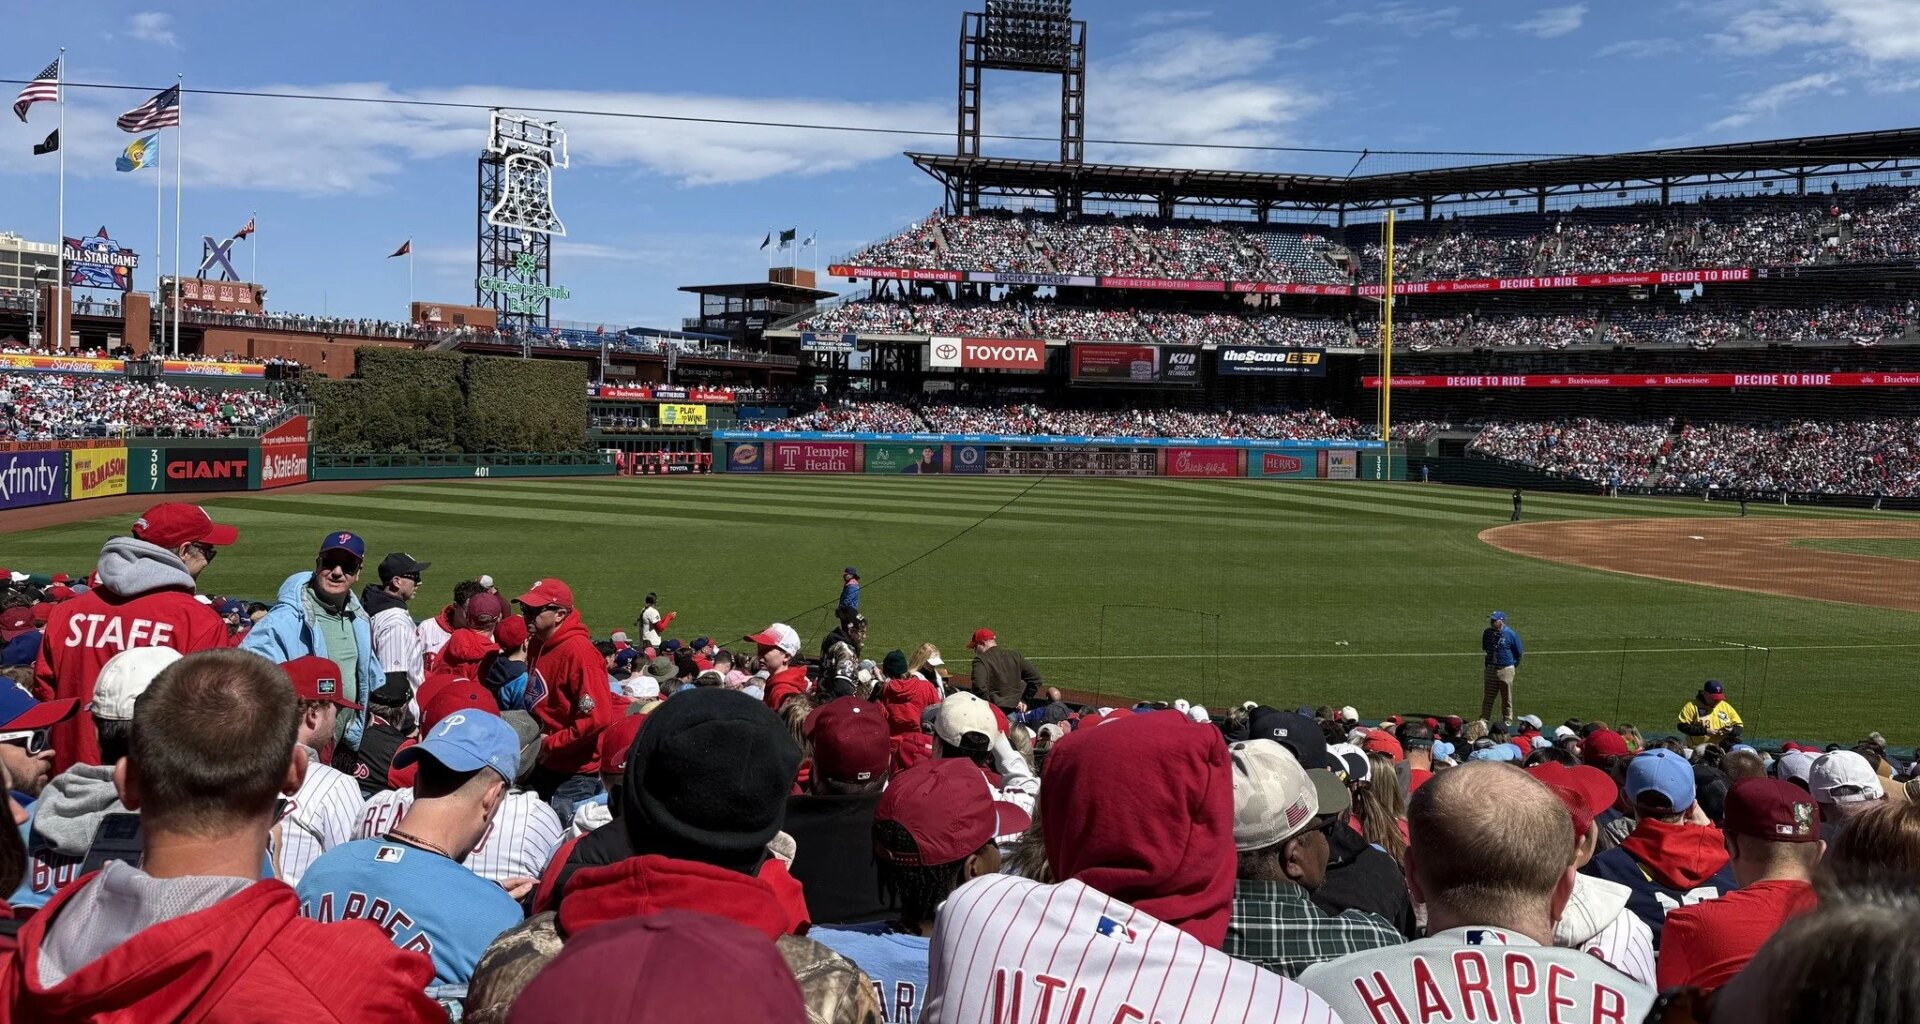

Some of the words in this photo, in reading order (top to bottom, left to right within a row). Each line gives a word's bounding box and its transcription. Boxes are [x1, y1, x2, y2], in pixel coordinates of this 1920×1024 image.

[63, 247, 83, 261] ALL
[84, 249, 110, 265] STAR
[110, 252, 137, 267] GAME
[854, 268, 882, 278] Phillies
[882, 270, 897, 278] win
[913, 271, 935, 280] Deals
[935, 272, 947, 280] roll
[947, 272, 957, 280] in
[995, 274, 1032, 283] LISCIO'S
[1035, 275, 1070, 285] BAKERY
[1608, 276, 1649, 284] Budweiser
[1661, 272, 1700, 283] DECIDE
[1704, 270, 1718, 280] TO
[1722, 269, 1749, 280] RIDE
[479, 276, 537, 296] Citizens
[536, 281, 570, 300] Bank
[1106, 278, 1128, 286] WHEY
[1129, 279, 1156, 287] BETTER
[1158, 280, 1190, 289] PROTEIN
[1358, 285, 1385, 295] DECID
[1407, 283, 1429, 293] RIDE
[1453, 282, 1489, 290] Budweiser
[1500, 278, 1535, 289] DECIDE
[1538, 278, 1551, 287] TO
[1554, 277, 1578, 287] RIDE
[508, 297, 540, 315] Park
[966, 345, 1039, 362] TOYOTA
[1223, 350, 1287, 363] theScore
[51, 359, 93, 371] Surfside
[185, 363, 223, 374] Surfside
[1447, 377, 1483, 387] DECIDE
[1486, 377, 1498, 387] TO
[1502, 377, 1526, 387] RIDE
[1568, 377, 1609, 385] Budweiser
[1664, 376, 1709, 385] Budweiser
[1735, 375, 1779, 386] DECIDE
[1783, 375, 1798, 386] TO
[1802, 375, 1832, 386] RIDE
[616, 390, 645, 398] Budweiser
[703, 393, 729, 401] Budweiser
[680, 407, 696, 415] PLAY
[17, 441, 52, 451] ASPLUNDH
[58, 440, 88, 449] ASPLUNDH
[94, 439, 121, 448] ASPLUNDH
[804, 446, 849, 458] Temple
[96, 457, 126, 482] MASON
[150, 449, 158, 490] 387
[166, 460, 247, 479] GIANT
[805, 460, 846, 471] Health
[1266, 458, 1297, 470] HERR'S
[474, 466, 489, 477] 401
[0, 456, 58, 500] xfinity
[338, 533, 352, 544] P
[65, 613, 174, 650] STAFF
[438, 714, 466, 737] P
[1352, 949, 1629, 1024] HARPER
